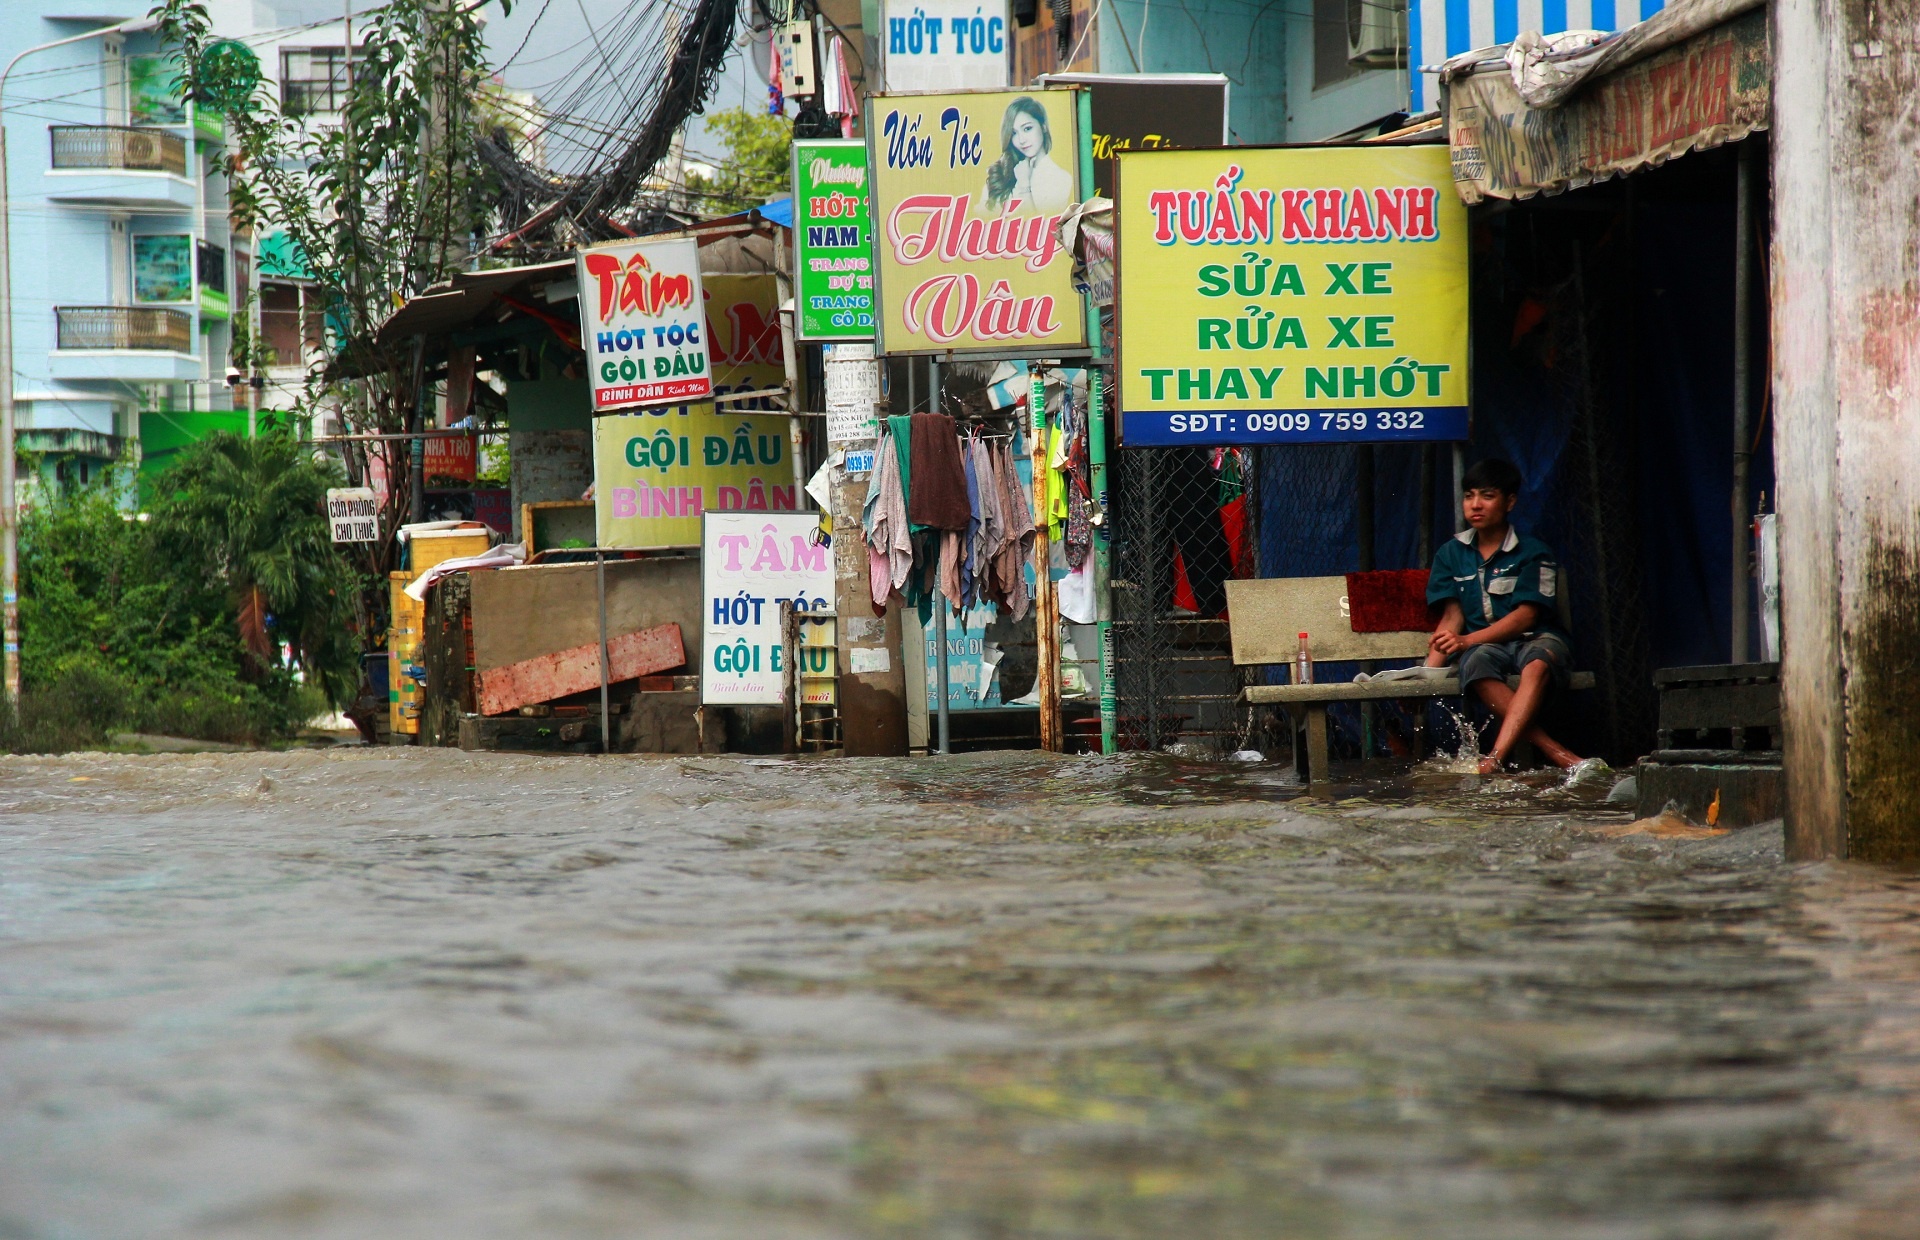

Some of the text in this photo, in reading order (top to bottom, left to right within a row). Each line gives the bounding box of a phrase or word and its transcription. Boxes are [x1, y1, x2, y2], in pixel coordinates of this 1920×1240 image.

[889, 10, 943, 55] HỚT
[952, 7, 1003, 54] TÓC
[940, 106, 983, 169] Tóc
[809, 191, 858, 217] HỚT
[1150, 164, 1440, 246] TUẤN KHANH
[808, 226, 859, 248] NAM
[886, 194, 1065, 273] Thúy
[809, 258, 869, 271] TRANG
[829, 274, 855, 291] DỰ
[1197, 251, 1393, 298] SỬA XE
[585, 252, 694, 325] Tâm
[811, 296, 870, 309] TRANG
[831, 310, 855, 326] CÔ
[903, 273, 1060, 343] Vân
[597, 319, 699, 353] HỚT TÓC
[1198, 305, 1395, 350] RỬA XE
[601, 347, 704, 386] GỘI ĐẦU
[1141, 368, 1285, 401] THAY
[1305, 356, 1450, 399] NHỚT
[601, 385, 633, 402] BÌNH
[637, 384, 664, 398] DÂN
[1170, 411, 1425, 432] SĐT: 0909 759 332
[450, 439, 470, 460] TRỌ
[625, 422, 781, 473] GỘI ĐẦU
[348, 496, 375, 517] PHÒNG
[612, 478, 796, 518] BÌNH DÂN
[335, 523, 351, 540] CHO
[718, 523, 828, 572] TÂM
[713, 590, 765, 625] HỚT
[714, 637, 760, 678] GỘI
[711, 682, 764, 692] Bình dân
